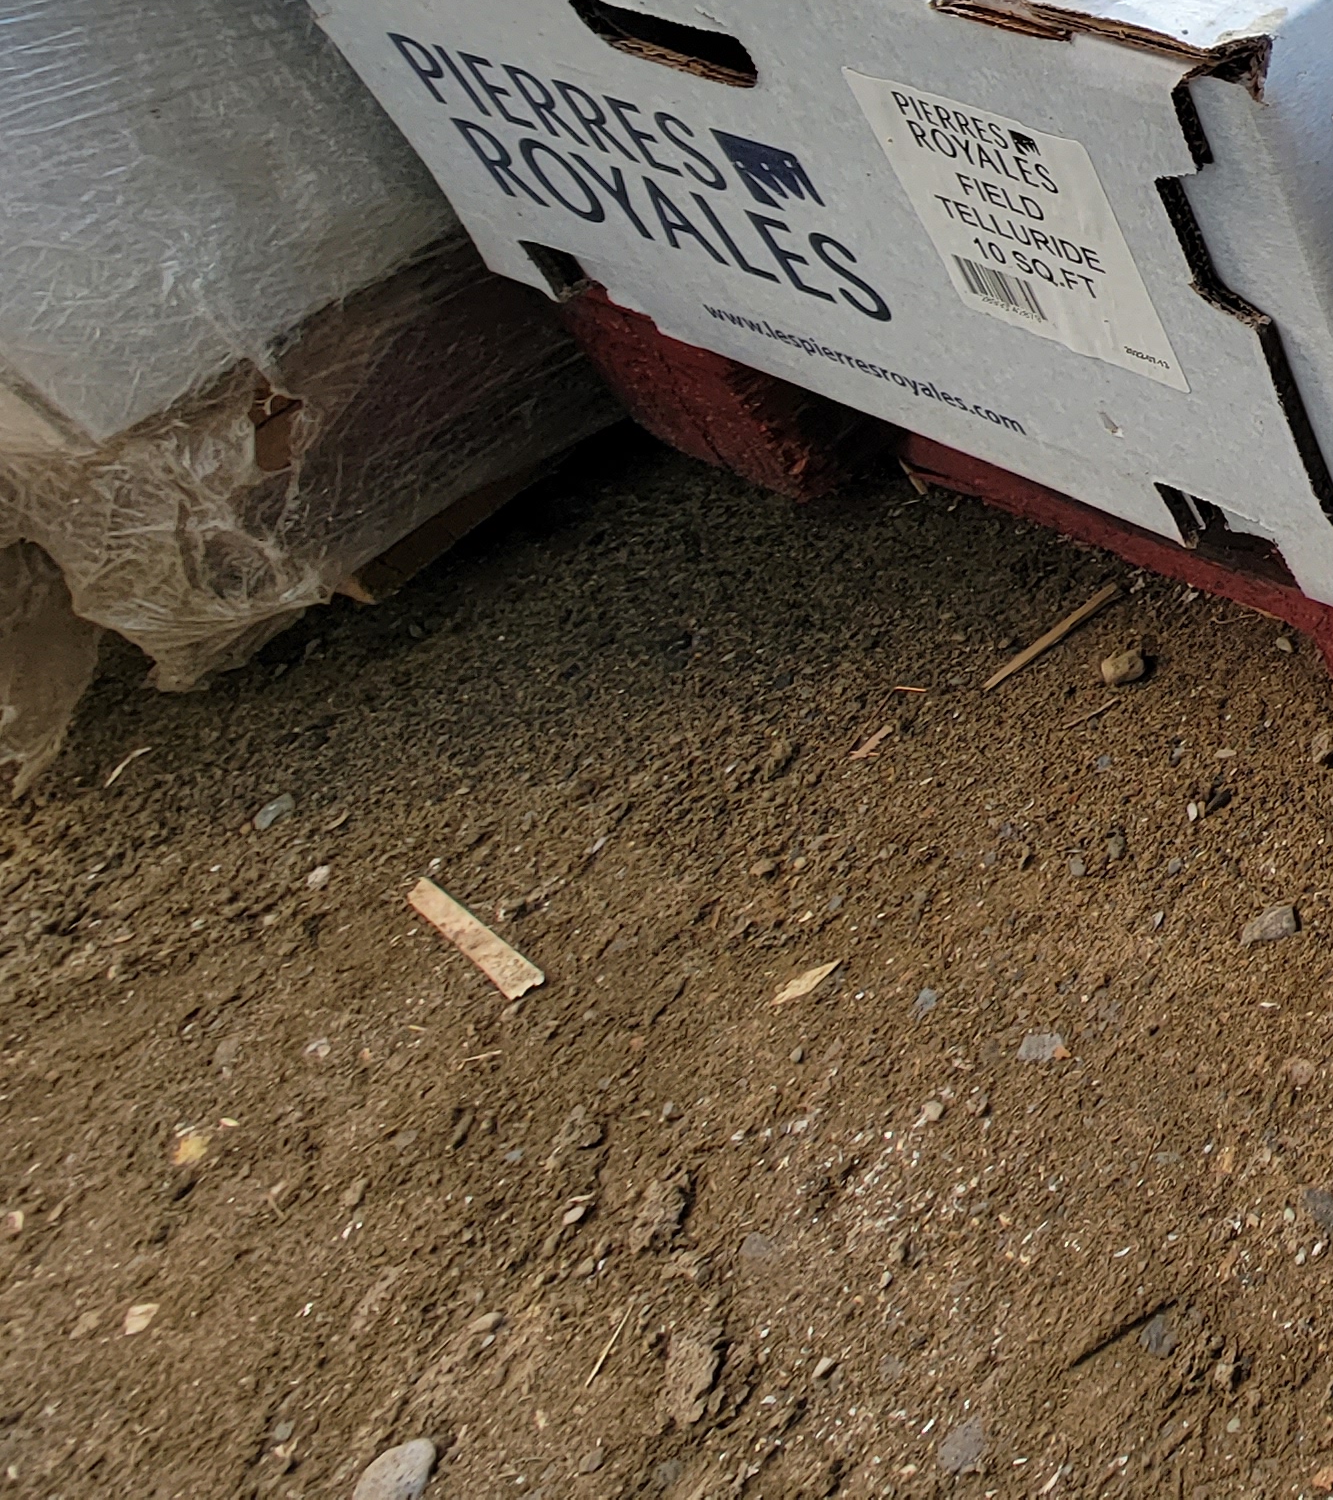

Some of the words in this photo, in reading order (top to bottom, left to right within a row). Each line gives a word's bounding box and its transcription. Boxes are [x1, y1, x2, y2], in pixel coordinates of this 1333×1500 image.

[387, 32, 727, 190] PIERRES
[890, 90, 1009, 150] PIERRES
[906, 119, 1059, 194] ROYALES
[451, 117, 892, 322] ROYALES
[934, 195, 1106, 274] TELLURIDE
[955, 172, 1045, 221] FIELD
[973, 237, 1007, 265] 10
[1012, 250, 1097, 299] SQ.FT
[703, 303, 1027, 436] www.lespierresroyales.com
